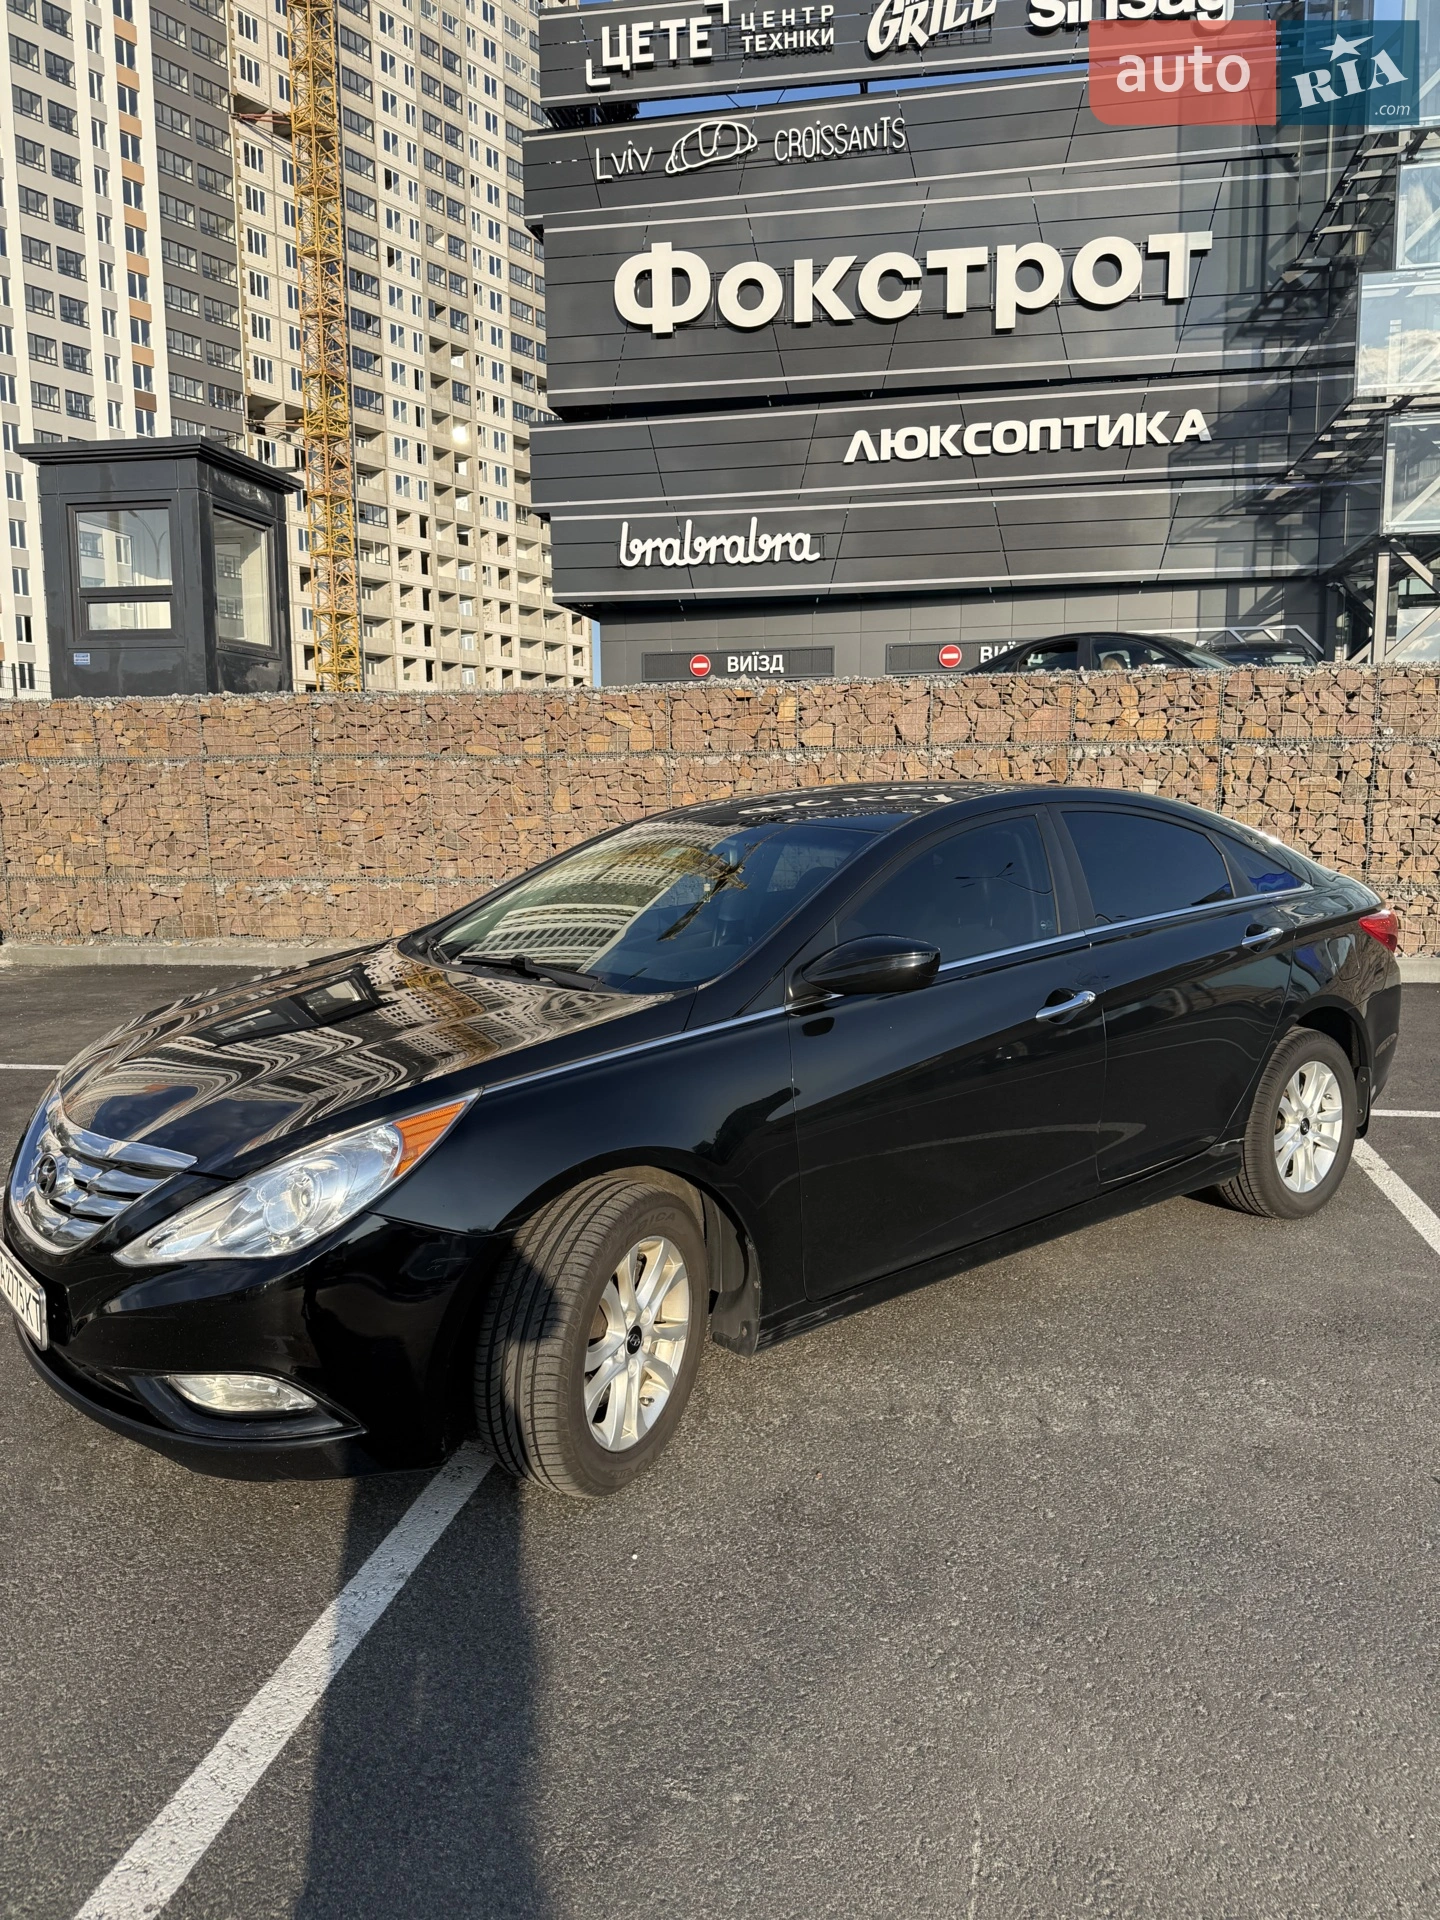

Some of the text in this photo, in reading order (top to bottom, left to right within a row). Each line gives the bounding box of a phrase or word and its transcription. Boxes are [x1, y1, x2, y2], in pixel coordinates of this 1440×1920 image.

[602, 15, 713, 71] ЦЕТЕ
[741, 4, 834, 31] ЦЕНТР
[741, 28, 834, 53] ТЕХНІКИ
[867, 0, 997, 53] GRILL
[613, 230, 1213, 334] Фокстрот
[843, 408, 1213, 464] ЛЮКСОПТИКА
[619, 516, 821, 567] brabrabra
[727, 651, 785, 674] ВИЇЗД
